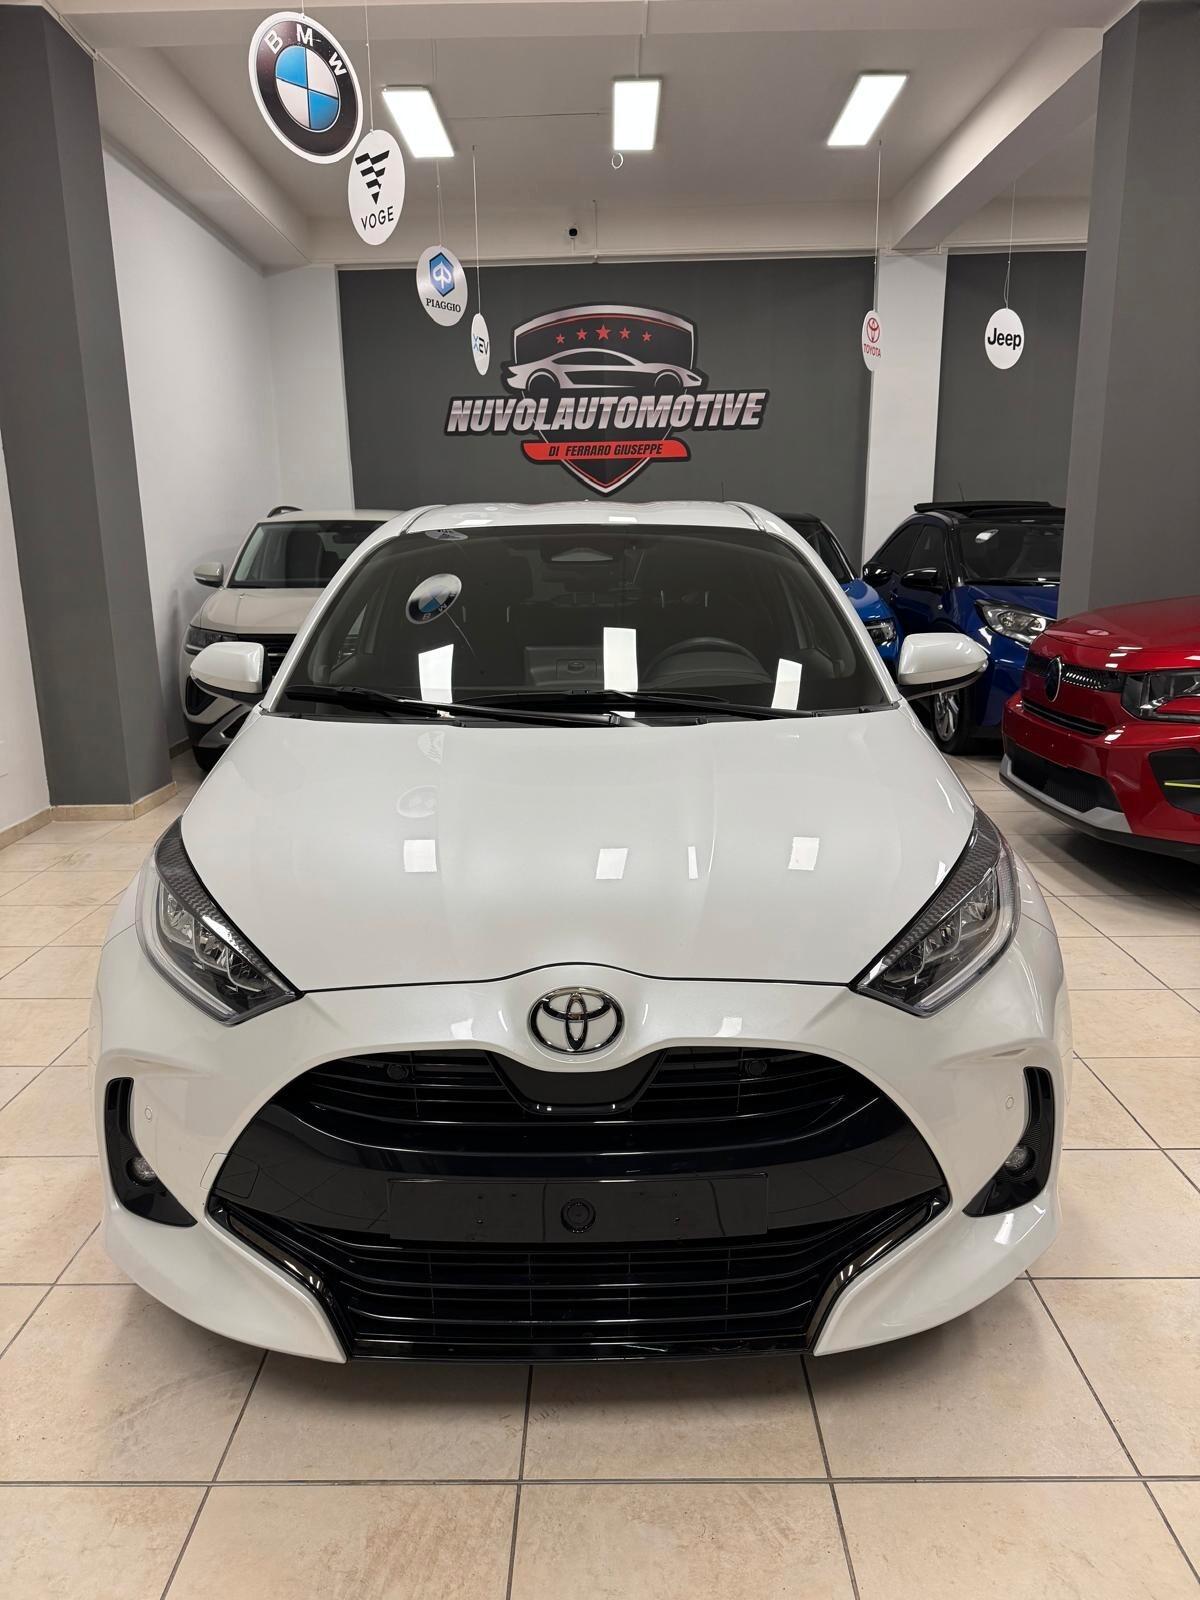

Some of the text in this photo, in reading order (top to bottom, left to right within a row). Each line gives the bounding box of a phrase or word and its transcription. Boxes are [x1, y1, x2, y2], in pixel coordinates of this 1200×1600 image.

[264, 23, 347, 77] BMW
[361, 206, 394, 231] VOGE
[426, 298, 461, 313] PIAGGIO
[473, 334, 490, 354] XEV
[987, 328, 1022, 350] Jeep
[863, 343, 881, 358] TOYOTA
[447, 392, 766, 432] NUVOLAUTOMOTIVE
[549, 443, 663, 457] DI FERRARO GIUSEPPE
